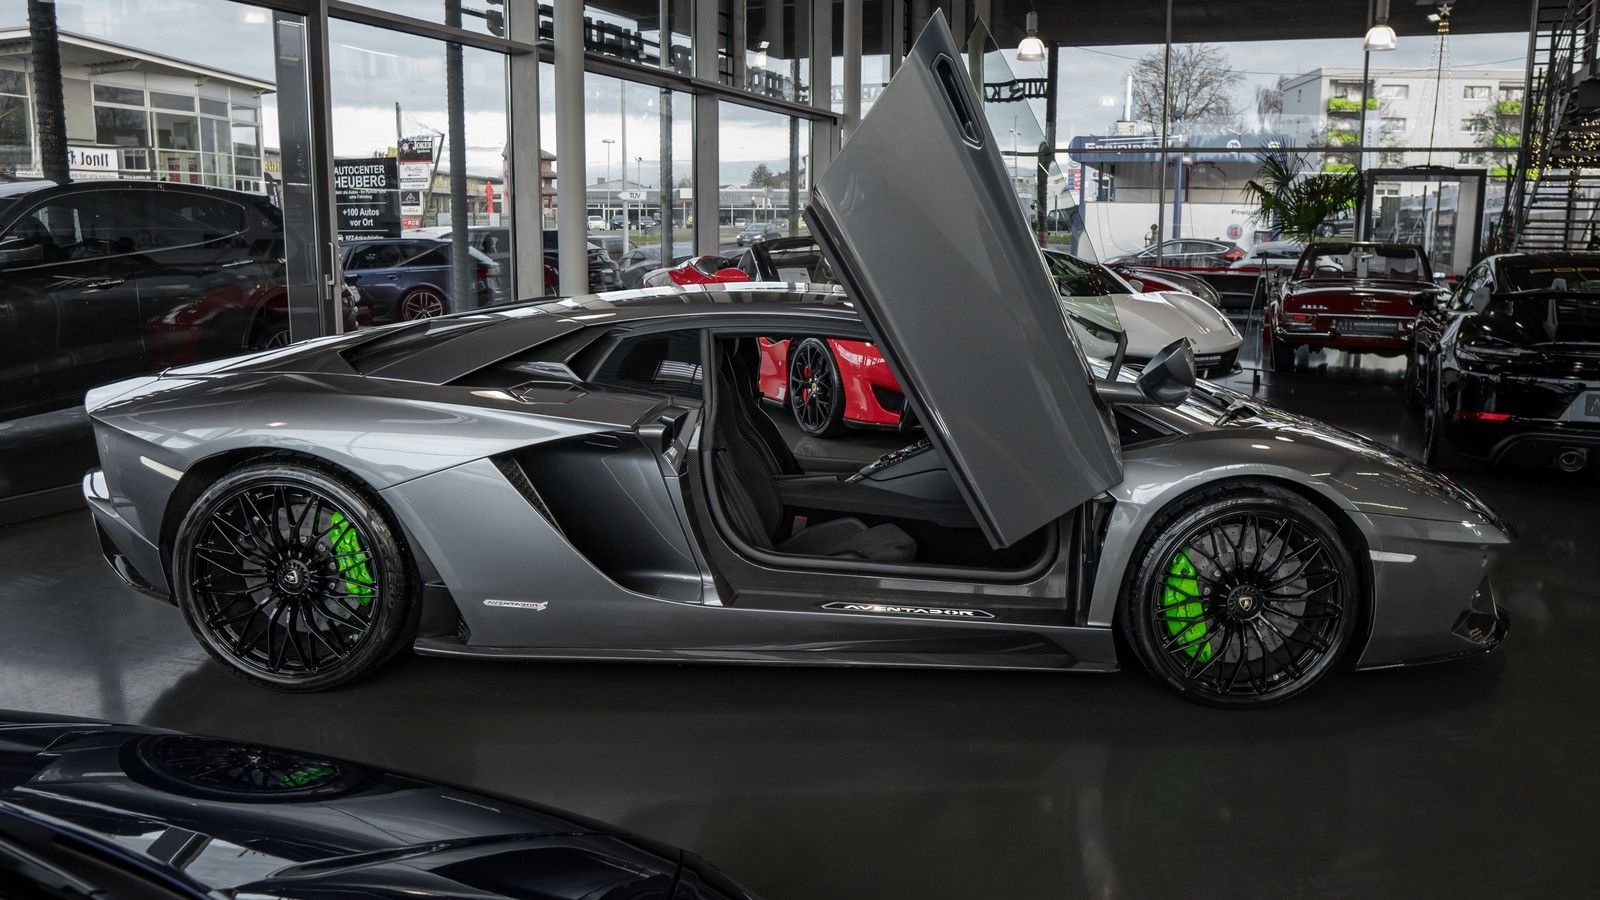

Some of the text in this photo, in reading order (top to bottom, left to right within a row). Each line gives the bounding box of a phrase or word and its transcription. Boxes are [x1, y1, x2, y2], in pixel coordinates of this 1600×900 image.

[334, 165, 385, 175] AUTOCENTER
[335, 175, 386, 188] HEUBERG
[342, 208, 380, 216] +100 Autos
[362, 218, 374, 226] Ort
[486, 600, 538, 608] AVENTADOR
[844, 604, 975, 616] AVENTADOR
